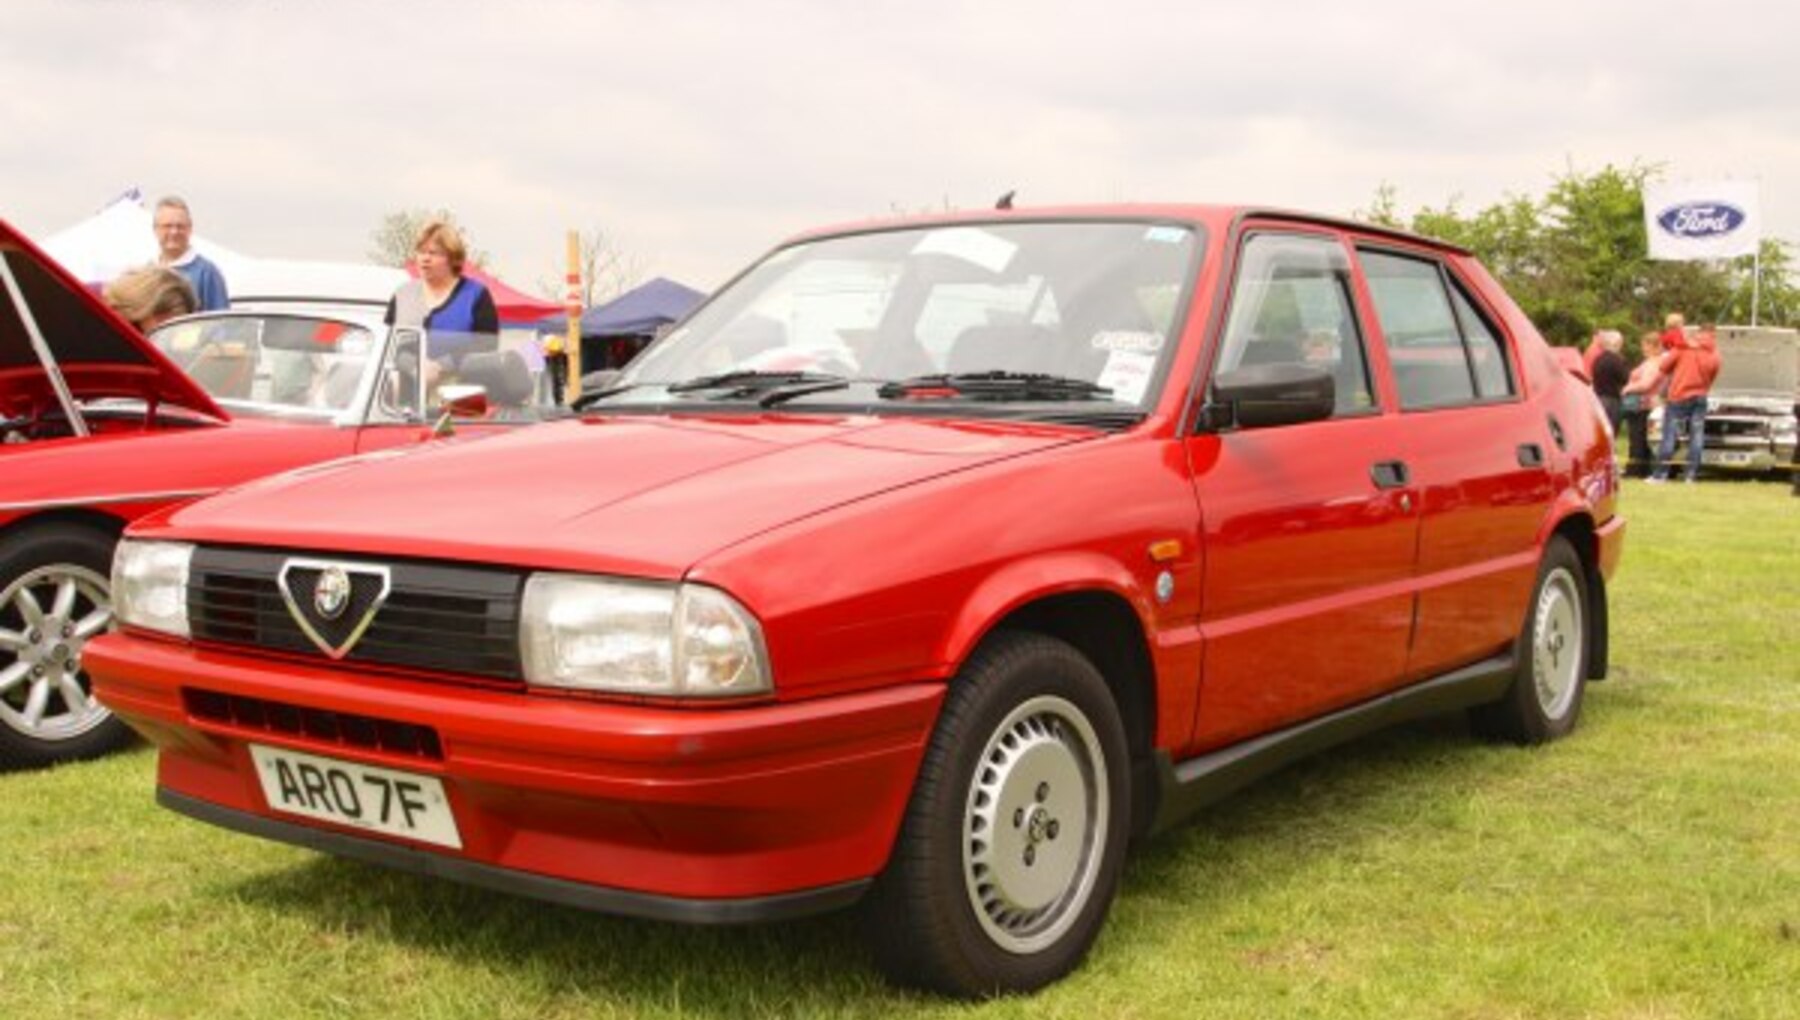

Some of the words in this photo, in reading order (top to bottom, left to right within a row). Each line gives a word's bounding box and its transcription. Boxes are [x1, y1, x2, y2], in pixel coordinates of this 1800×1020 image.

[1673, 208, 1730, 231] Ford
[275, 757, 362, 818] ARO
[362, 772, 427, 828] 7F
